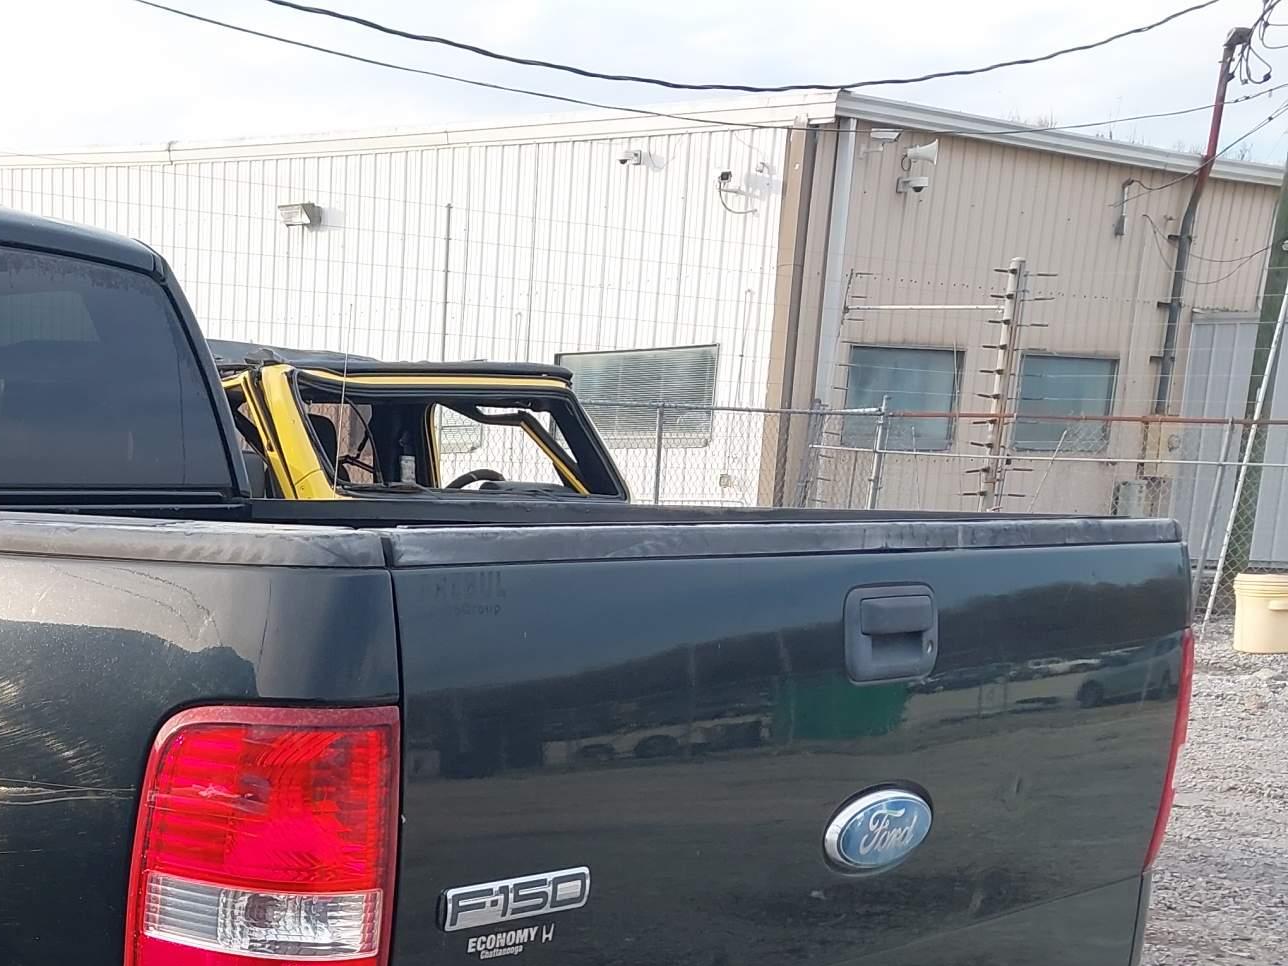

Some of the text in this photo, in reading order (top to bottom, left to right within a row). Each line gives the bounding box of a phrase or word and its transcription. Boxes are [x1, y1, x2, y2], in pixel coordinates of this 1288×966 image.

[859, 807, 918, 856] Ford
[449, 872, 587, 927] F-150
[467, 926, 538, 953] ECONOMY
[480, 944, 524, 960] Chattanooga
